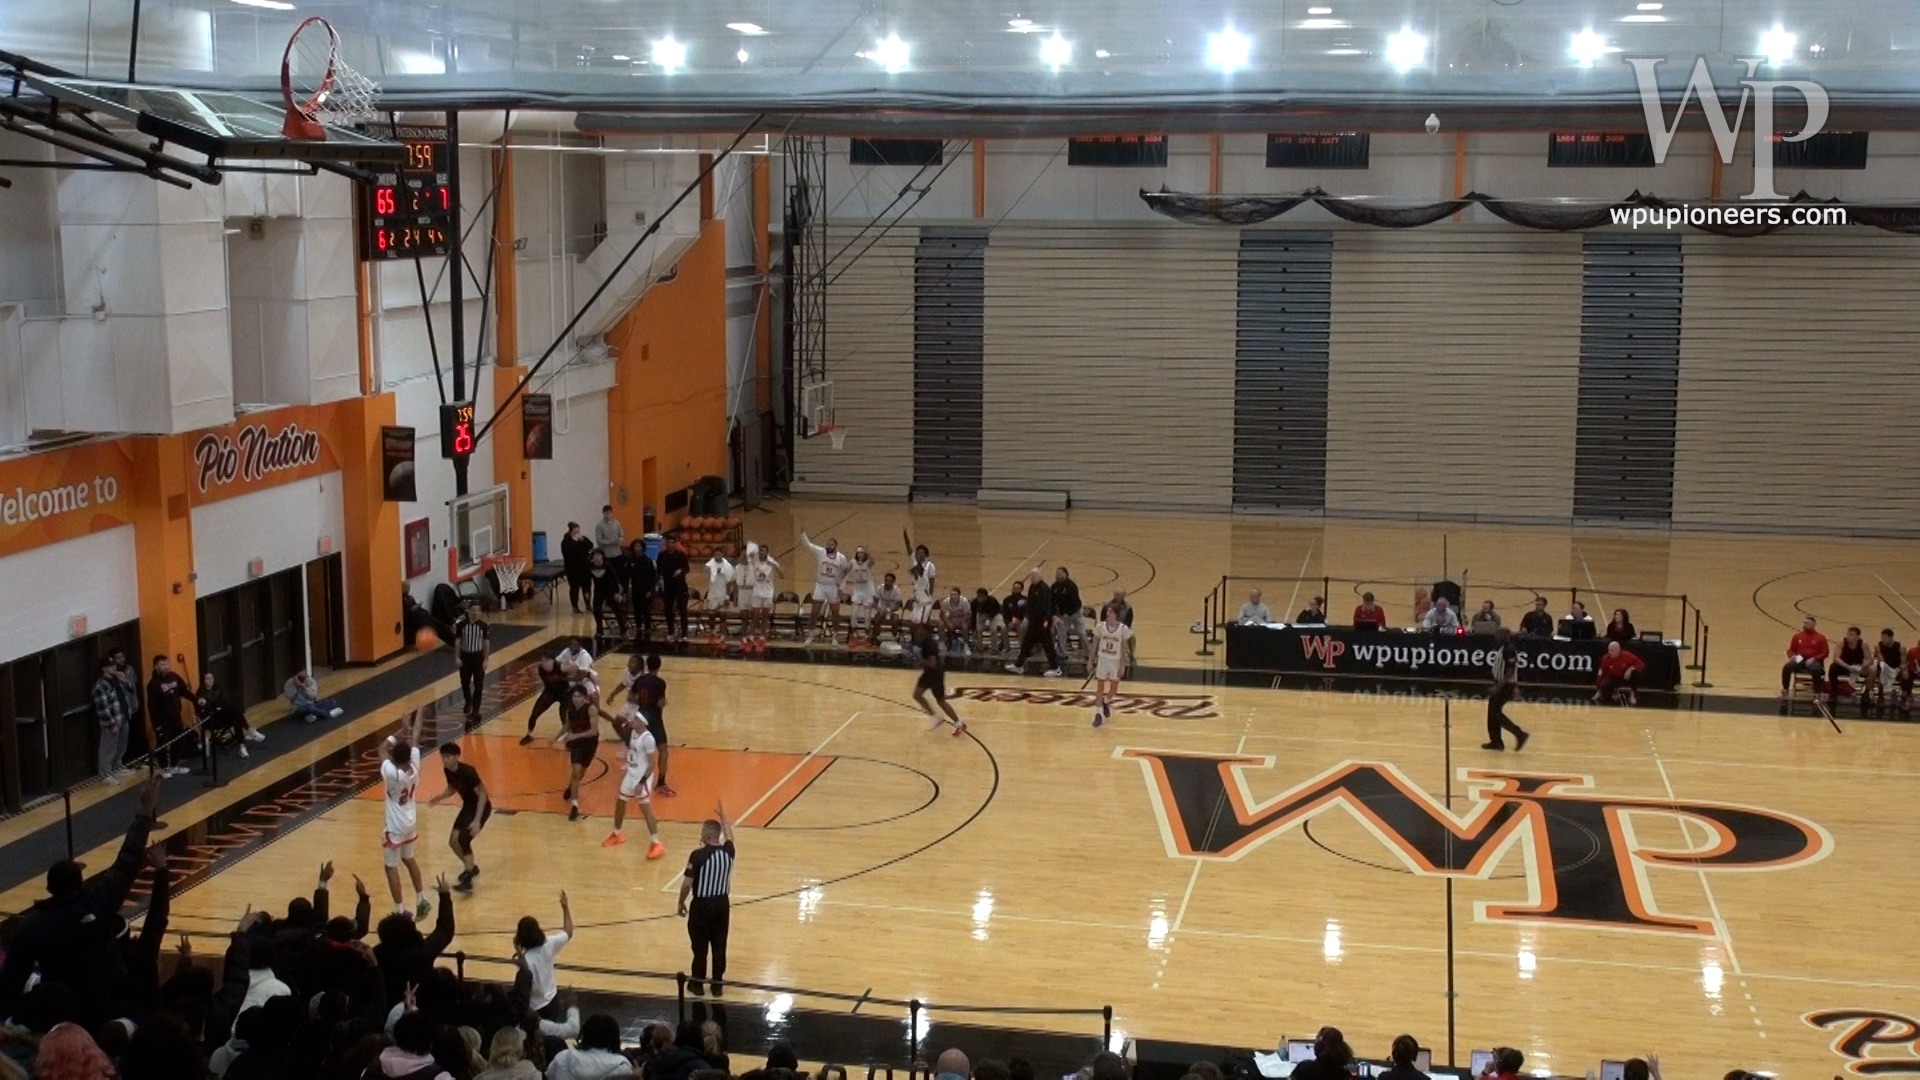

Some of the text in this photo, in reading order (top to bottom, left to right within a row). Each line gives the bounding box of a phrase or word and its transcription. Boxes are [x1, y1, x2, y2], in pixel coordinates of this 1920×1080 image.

[377, 188, 395, 214] 65
[195, 423, 320, 493] Pio Nation
[94, 475, 118, 502] to
[1300, 633, 1593, 672] WP wpupionees.com
[1110, 744, 1836, 939] WP
